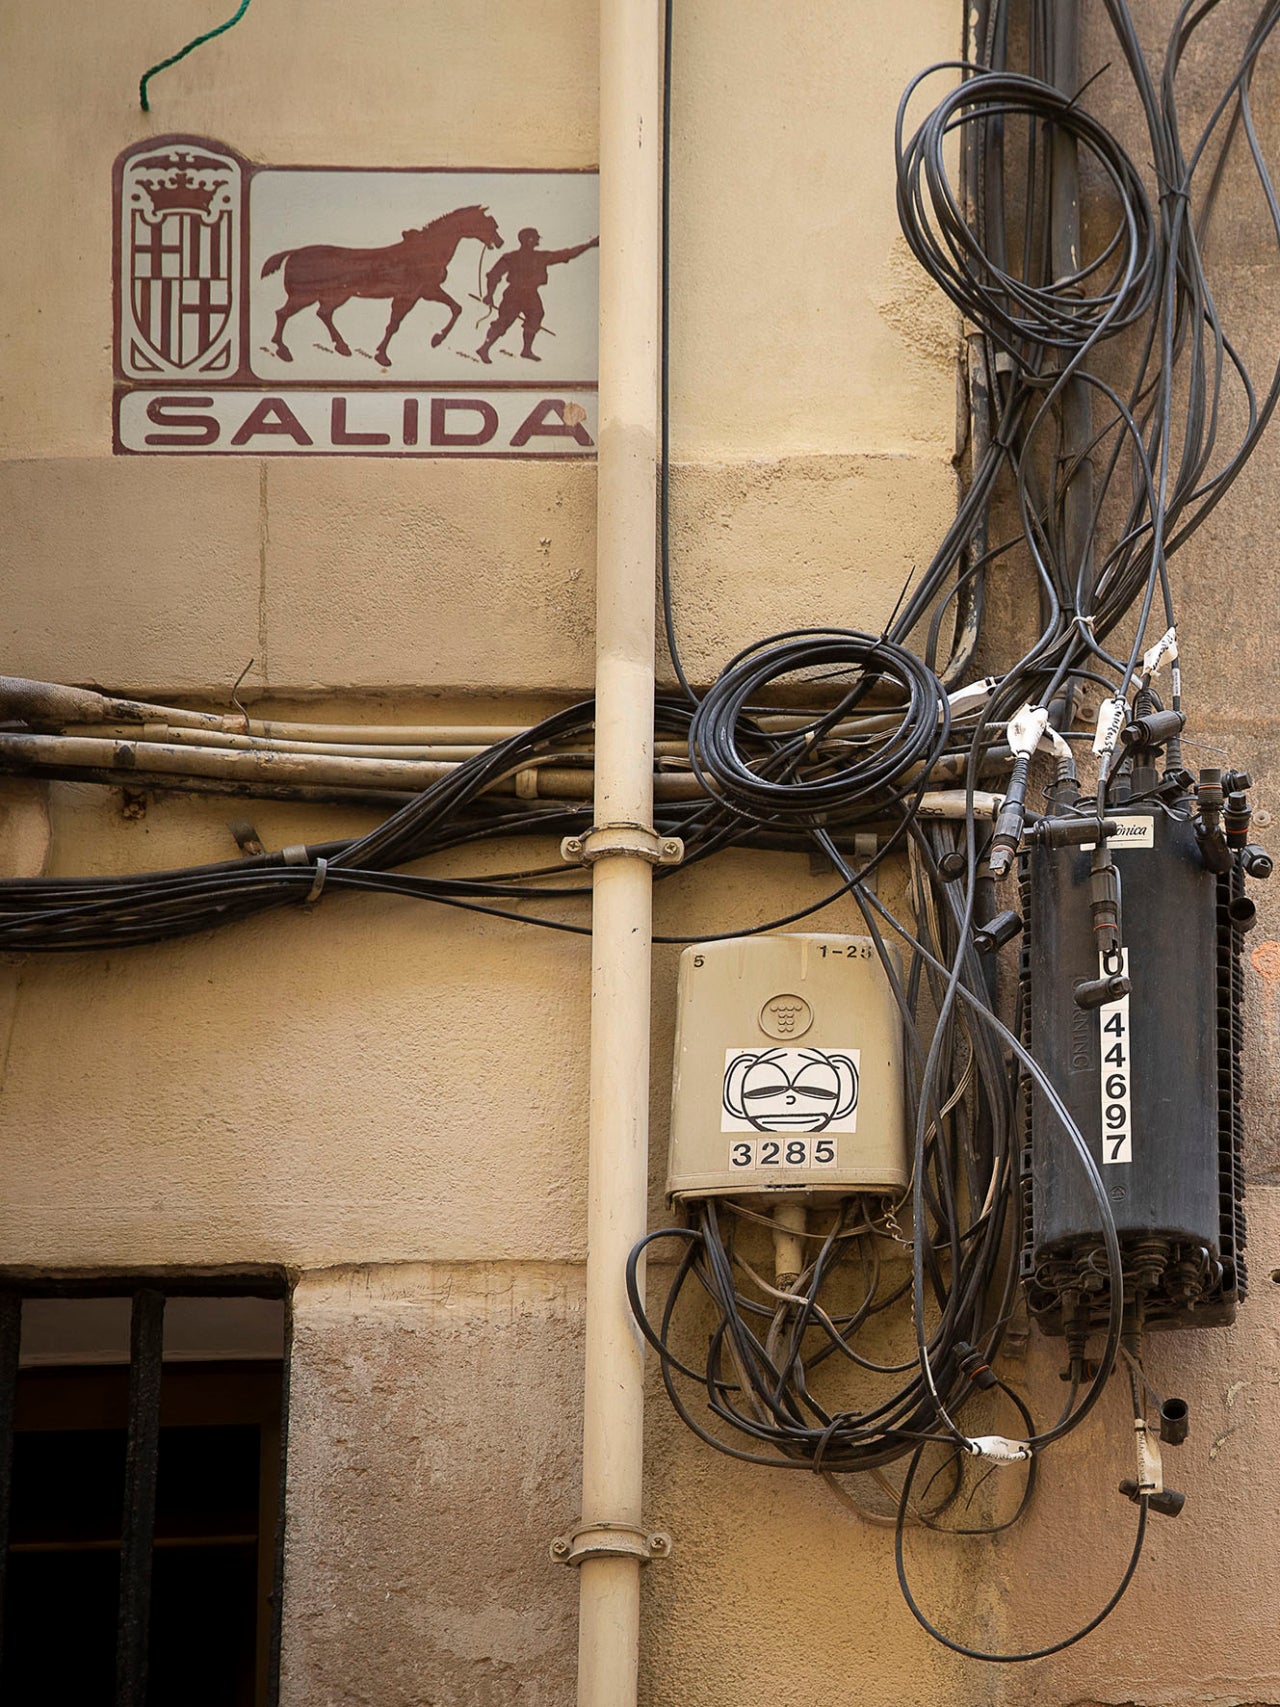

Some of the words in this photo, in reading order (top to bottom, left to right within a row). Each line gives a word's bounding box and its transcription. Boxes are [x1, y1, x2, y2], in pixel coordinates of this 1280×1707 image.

[145, 397, 595, 447] SALIDA
[1115, 823, 1148, 837] ónica
[693, 955, 705, 968] 5
[732, 1141, 835, 1167] 3285
